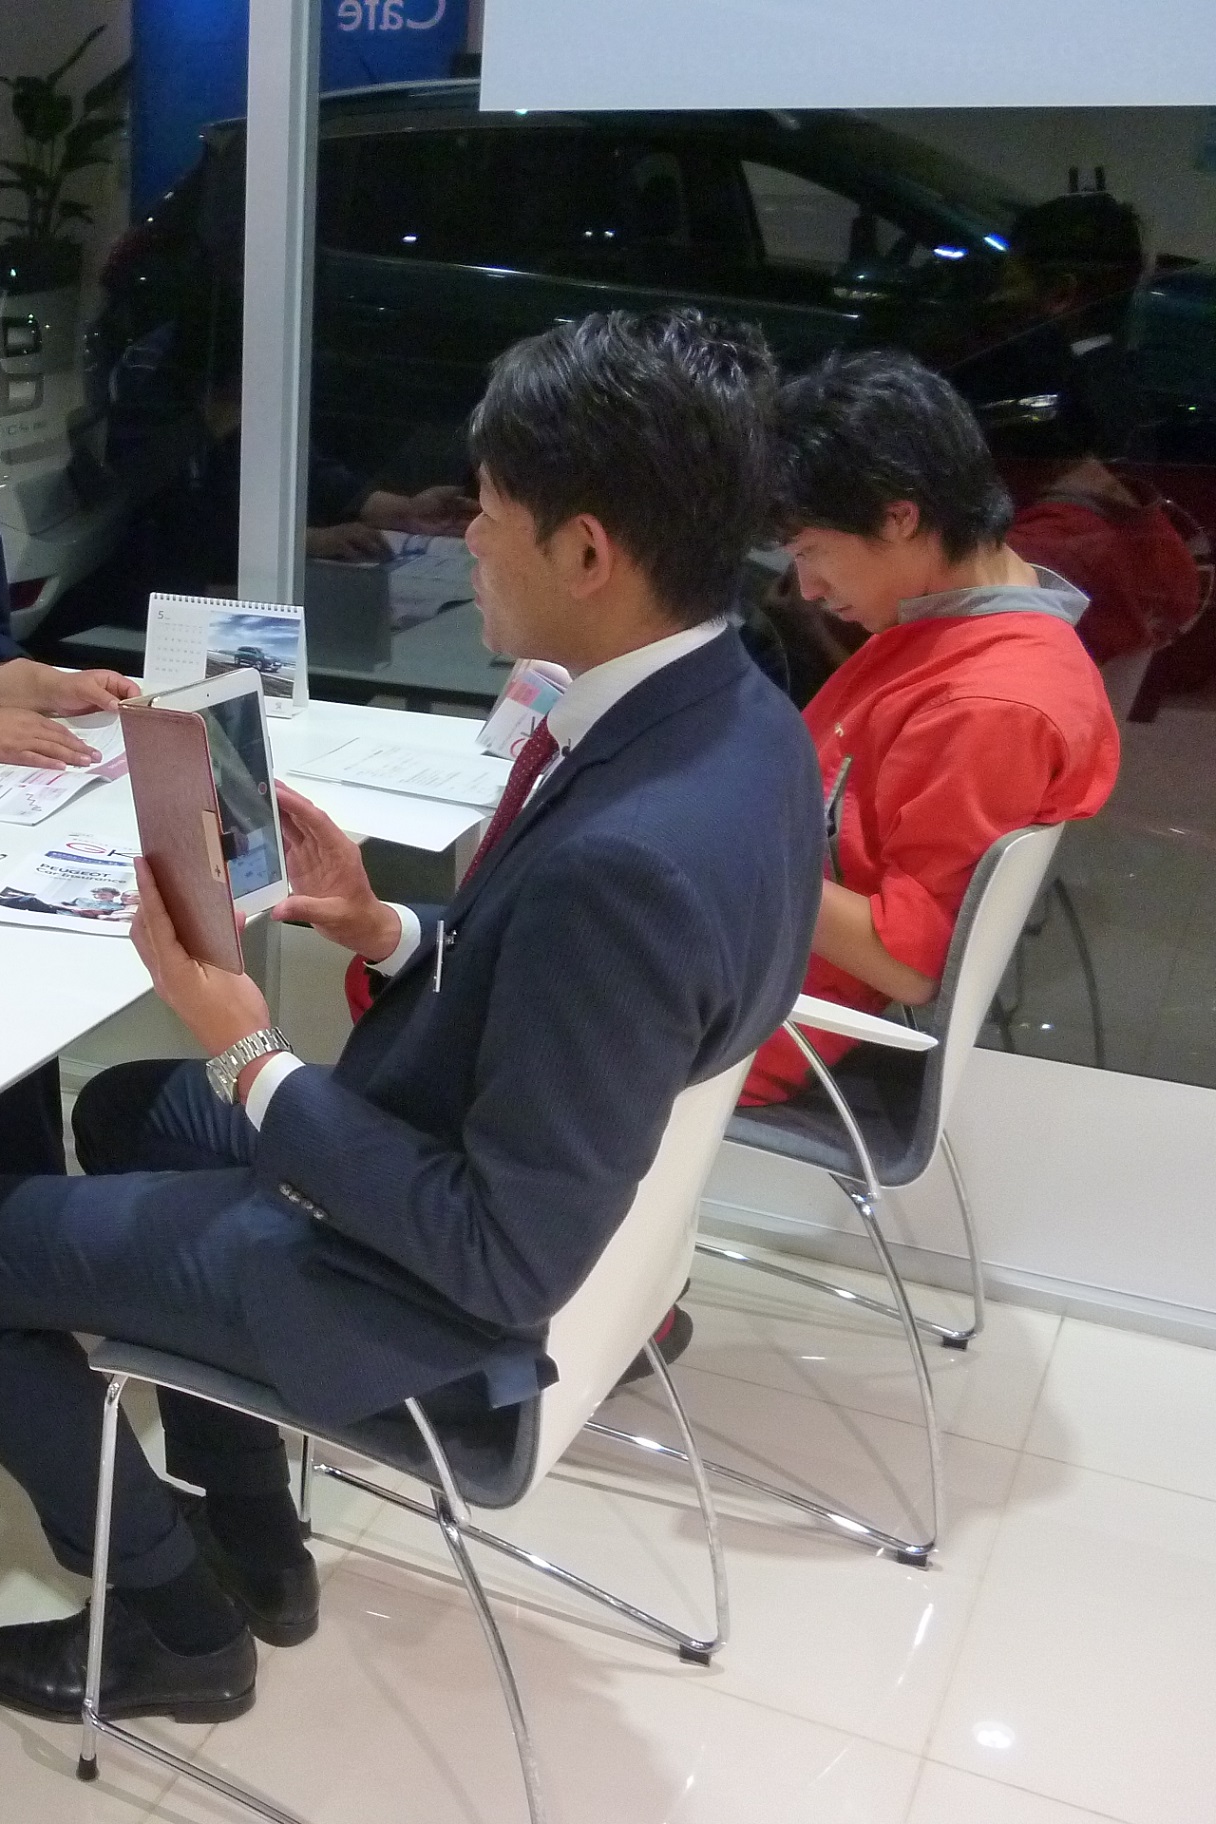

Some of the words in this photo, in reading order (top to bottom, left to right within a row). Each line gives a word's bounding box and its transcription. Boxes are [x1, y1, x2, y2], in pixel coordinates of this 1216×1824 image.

[158, 611, 164, 620] 5
[36, 867, 60, 876] Car
[62, 873, 127, 884] Insurance
[41, 863, 112, 878] PEUGEOT
